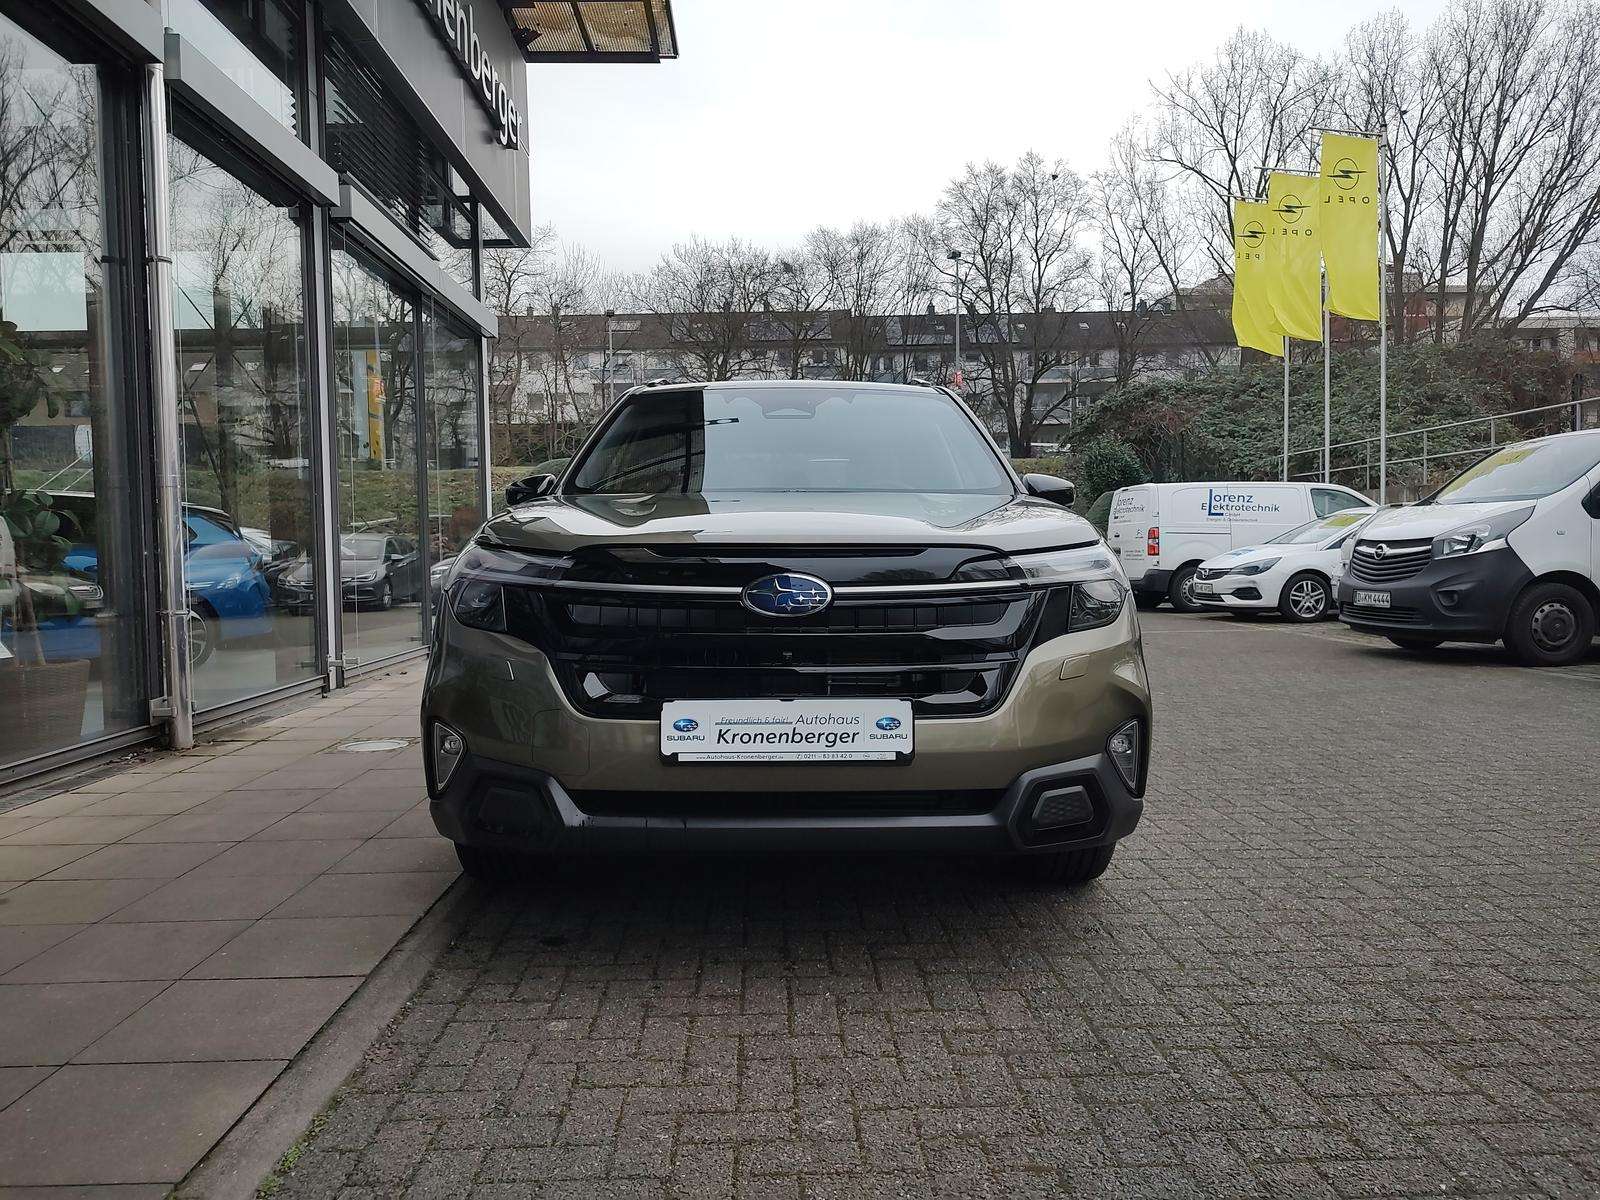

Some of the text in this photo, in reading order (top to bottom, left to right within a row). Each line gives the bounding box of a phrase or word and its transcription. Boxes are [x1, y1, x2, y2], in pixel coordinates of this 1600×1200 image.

[720, 716, 762, 724] Freundlich
[795, 713, 860, 725] Autohaus
[716, 727, 860, 748] Kronenberger
